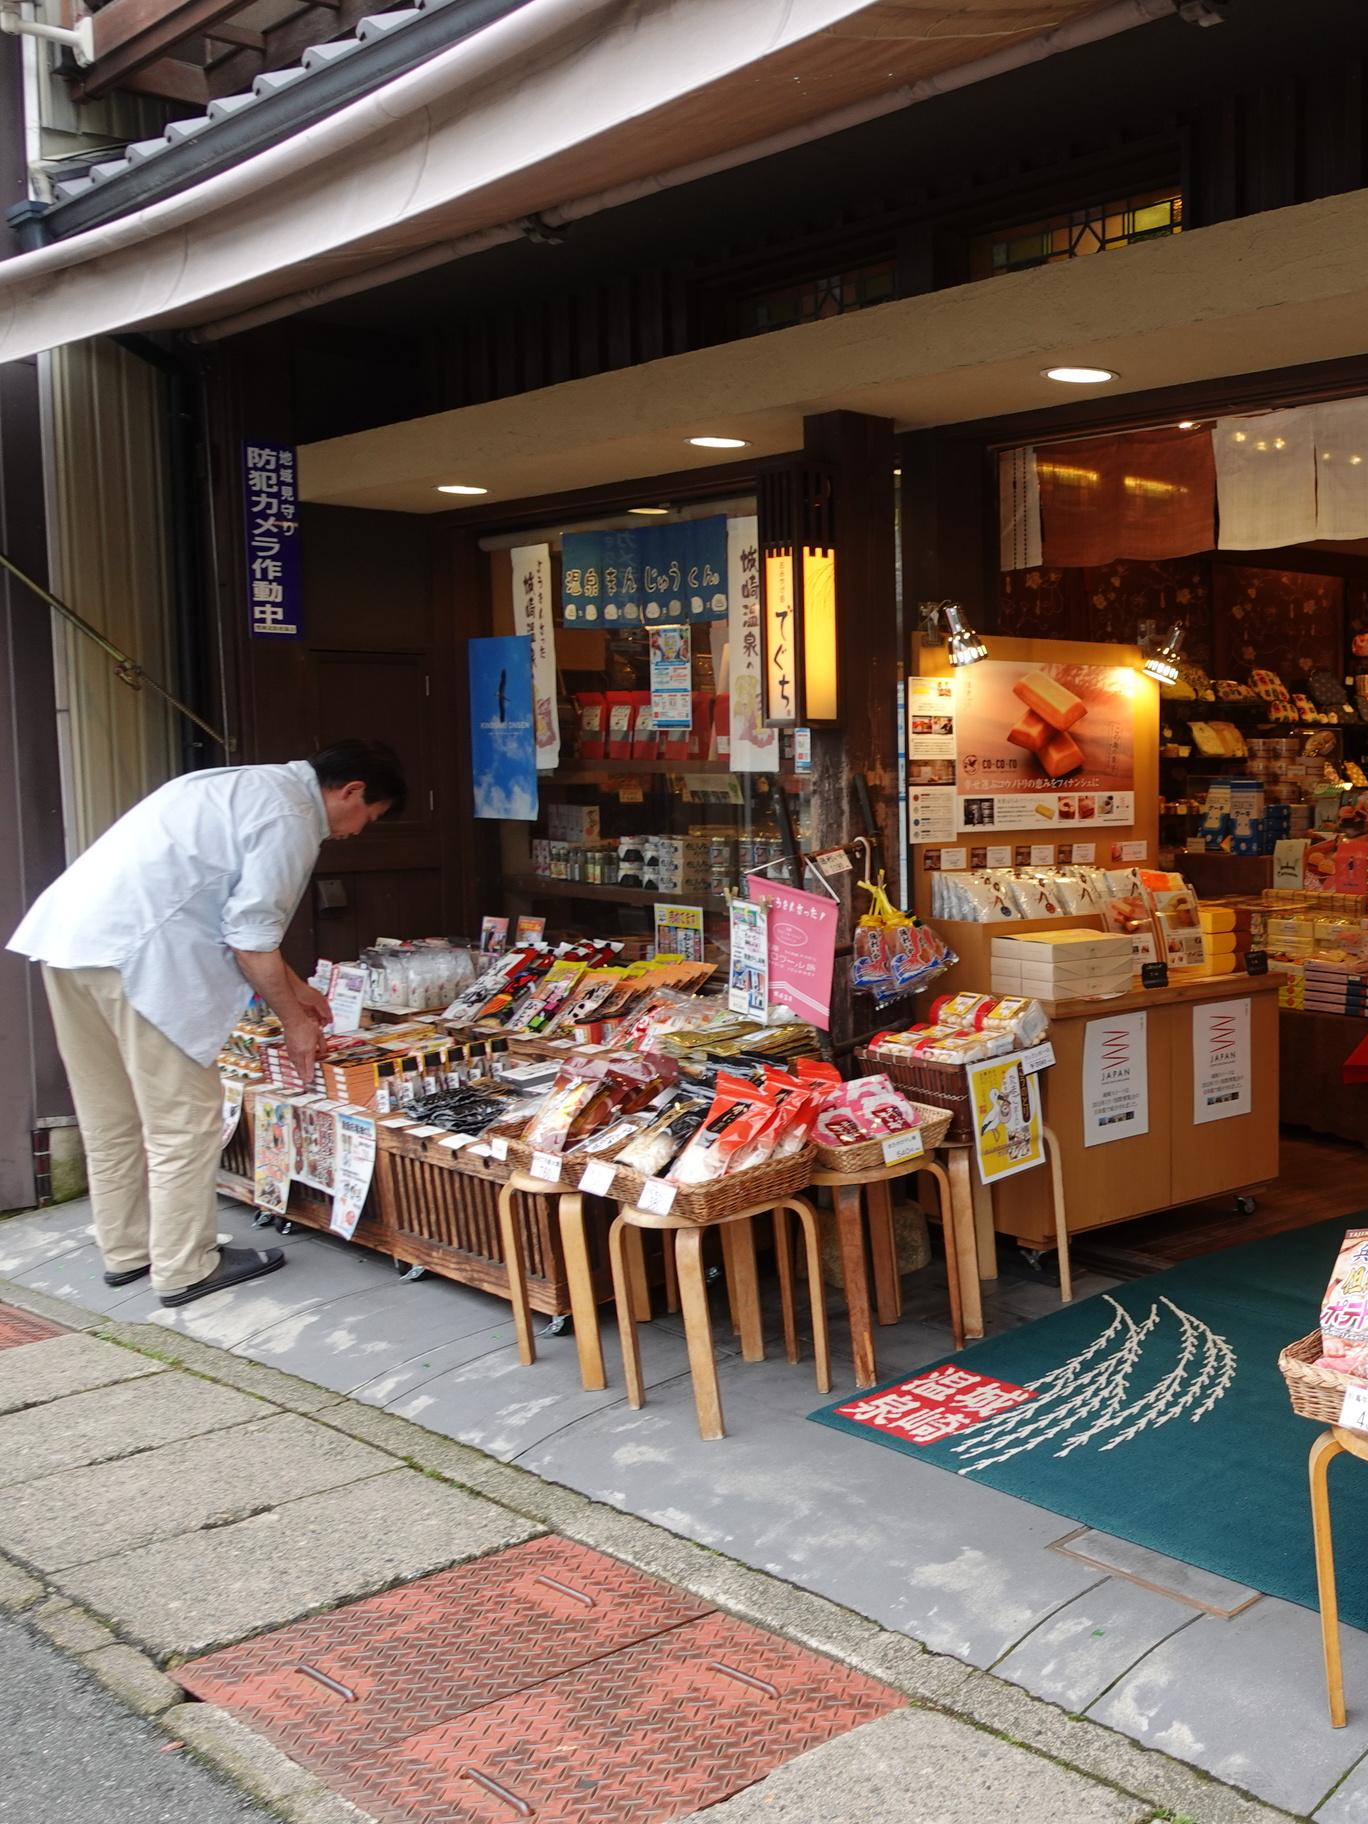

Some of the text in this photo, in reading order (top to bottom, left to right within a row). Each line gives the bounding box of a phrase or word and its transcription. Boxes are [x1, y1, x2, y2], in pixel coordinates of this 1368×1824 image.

[246, 446, 284, 625] 防犯カメラ作動中
[773, 604, 793, 708] でぐち
[1101, 1068, 1131, 1081] JAPAN
[1210, 1051, 1236, 1063] JAPAN
[839, 1366, 973, 1426] 温泉
[891, 1381, 1029, 1443] 城崎
